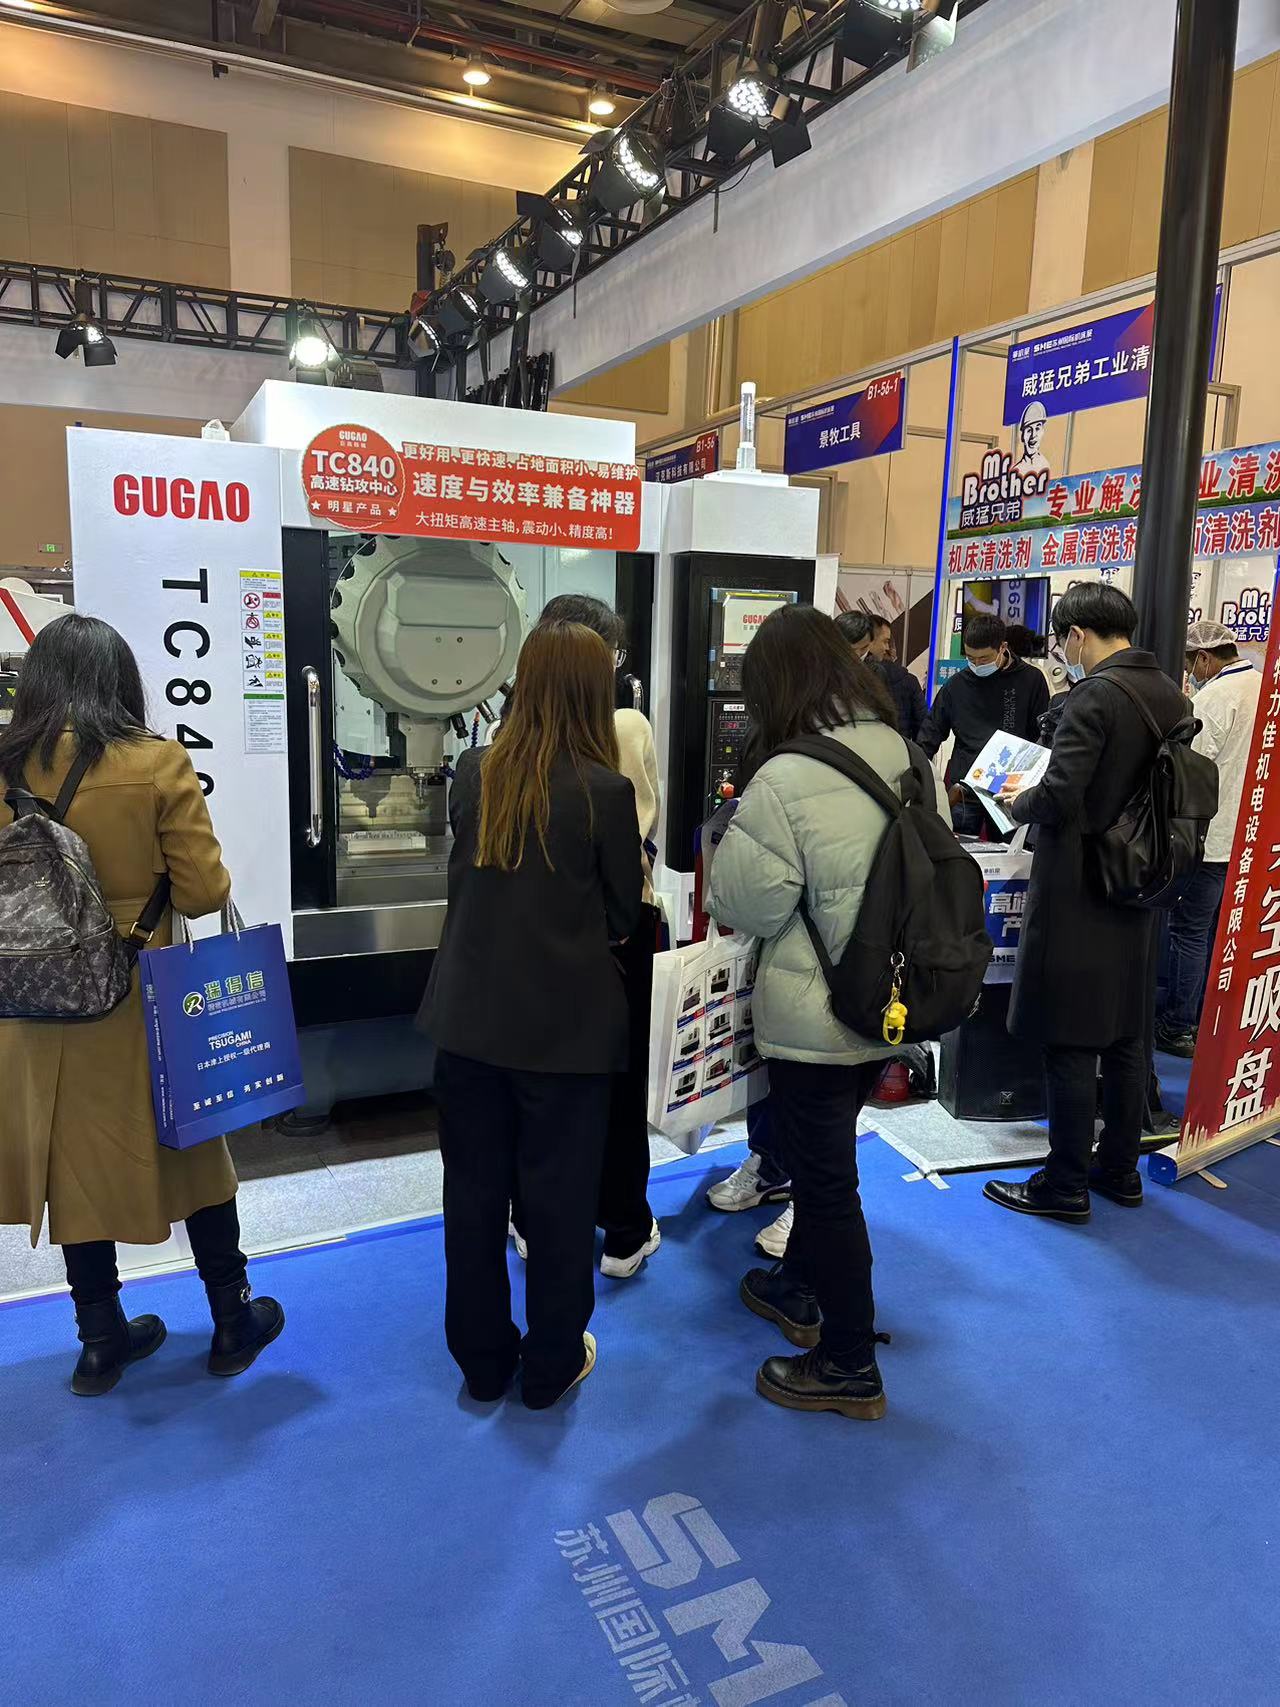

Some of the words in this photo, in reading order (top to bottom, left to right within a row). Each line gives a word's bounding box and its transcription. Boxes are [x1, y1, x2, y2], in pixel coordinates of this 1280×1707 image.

[1021, 344, 1150, 398] 威猛兄弟工业清
[867, 377, 899, 400] B1-56-1
[696, 435, 715, 453] B1-56
[819, 421, 861, 449] 景牧工具
[311, 449, 395, 479] TC840
[402, 442, 639, 481] 更好用、更快速、占地面积小、易维护
[982, 452, 1011, 481] Mr
[113, 473, 250, 523] GUGAO
[310, 474, 398, 496] 高速钻攻中心
[413, 471, 636, 516] 速度与效率兼备神器
[963, 471, 1048, 507] Brother
[327, 500, 381, 516] 明星产品
[961, 501, 1021, 527] 威猛兄弟
[948, 536, 1032, 574] 机床清洗剂
[1240, 589, 1268, 608] Mr
[209, 1030, 252, 1051] TSUGAMI
[235, 1039, 252, 1048] CHINA
[554, 1522, 701, 1707] 苏州国际
